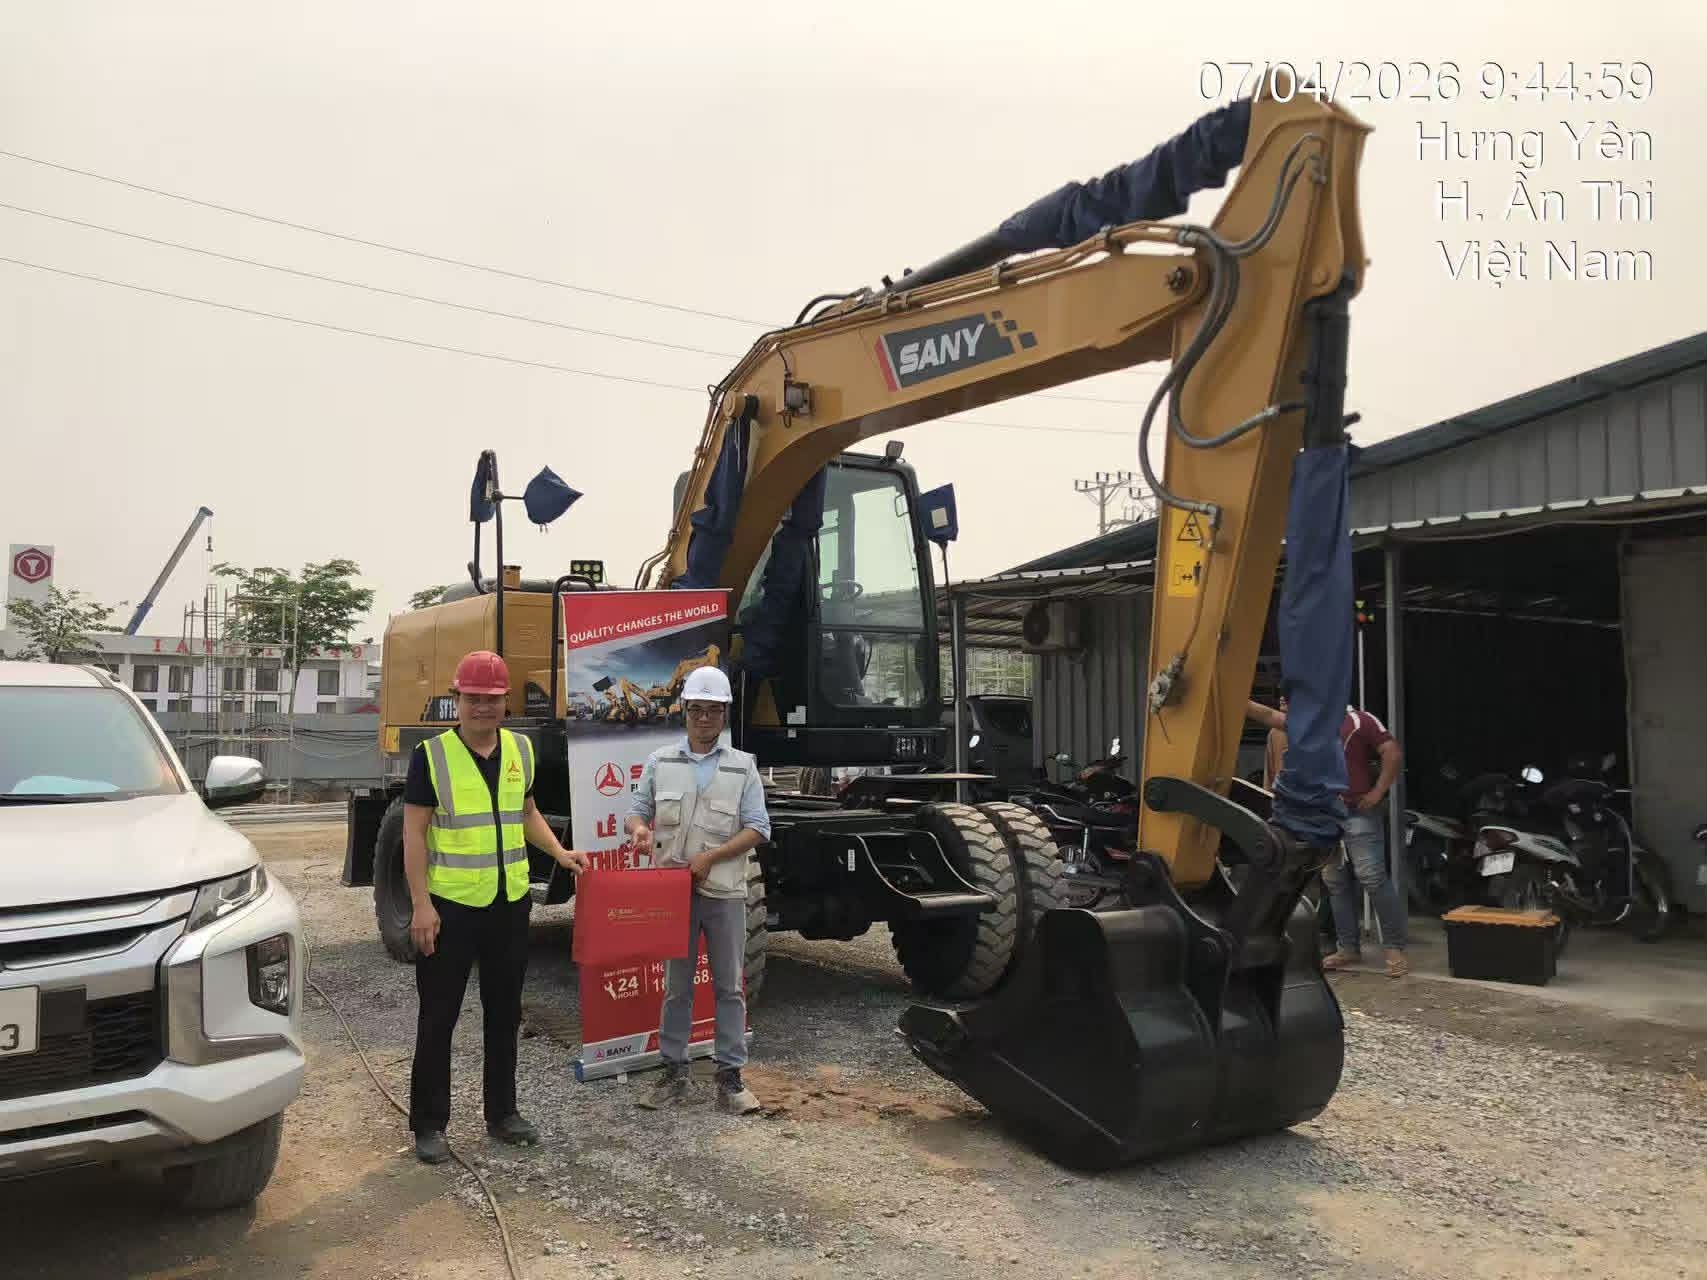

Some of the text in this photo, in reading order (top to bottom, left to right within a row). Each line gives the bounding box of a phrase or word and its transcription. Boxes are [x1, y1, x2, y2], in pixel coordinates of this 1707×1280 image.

[899, 323, 985, 375] SANY
[570, 603, 719, 644] QUALITY CHANGES THE WORLD
[617, 975, 639, 992] 24
[606, 1045, 631, 1057] SANY
